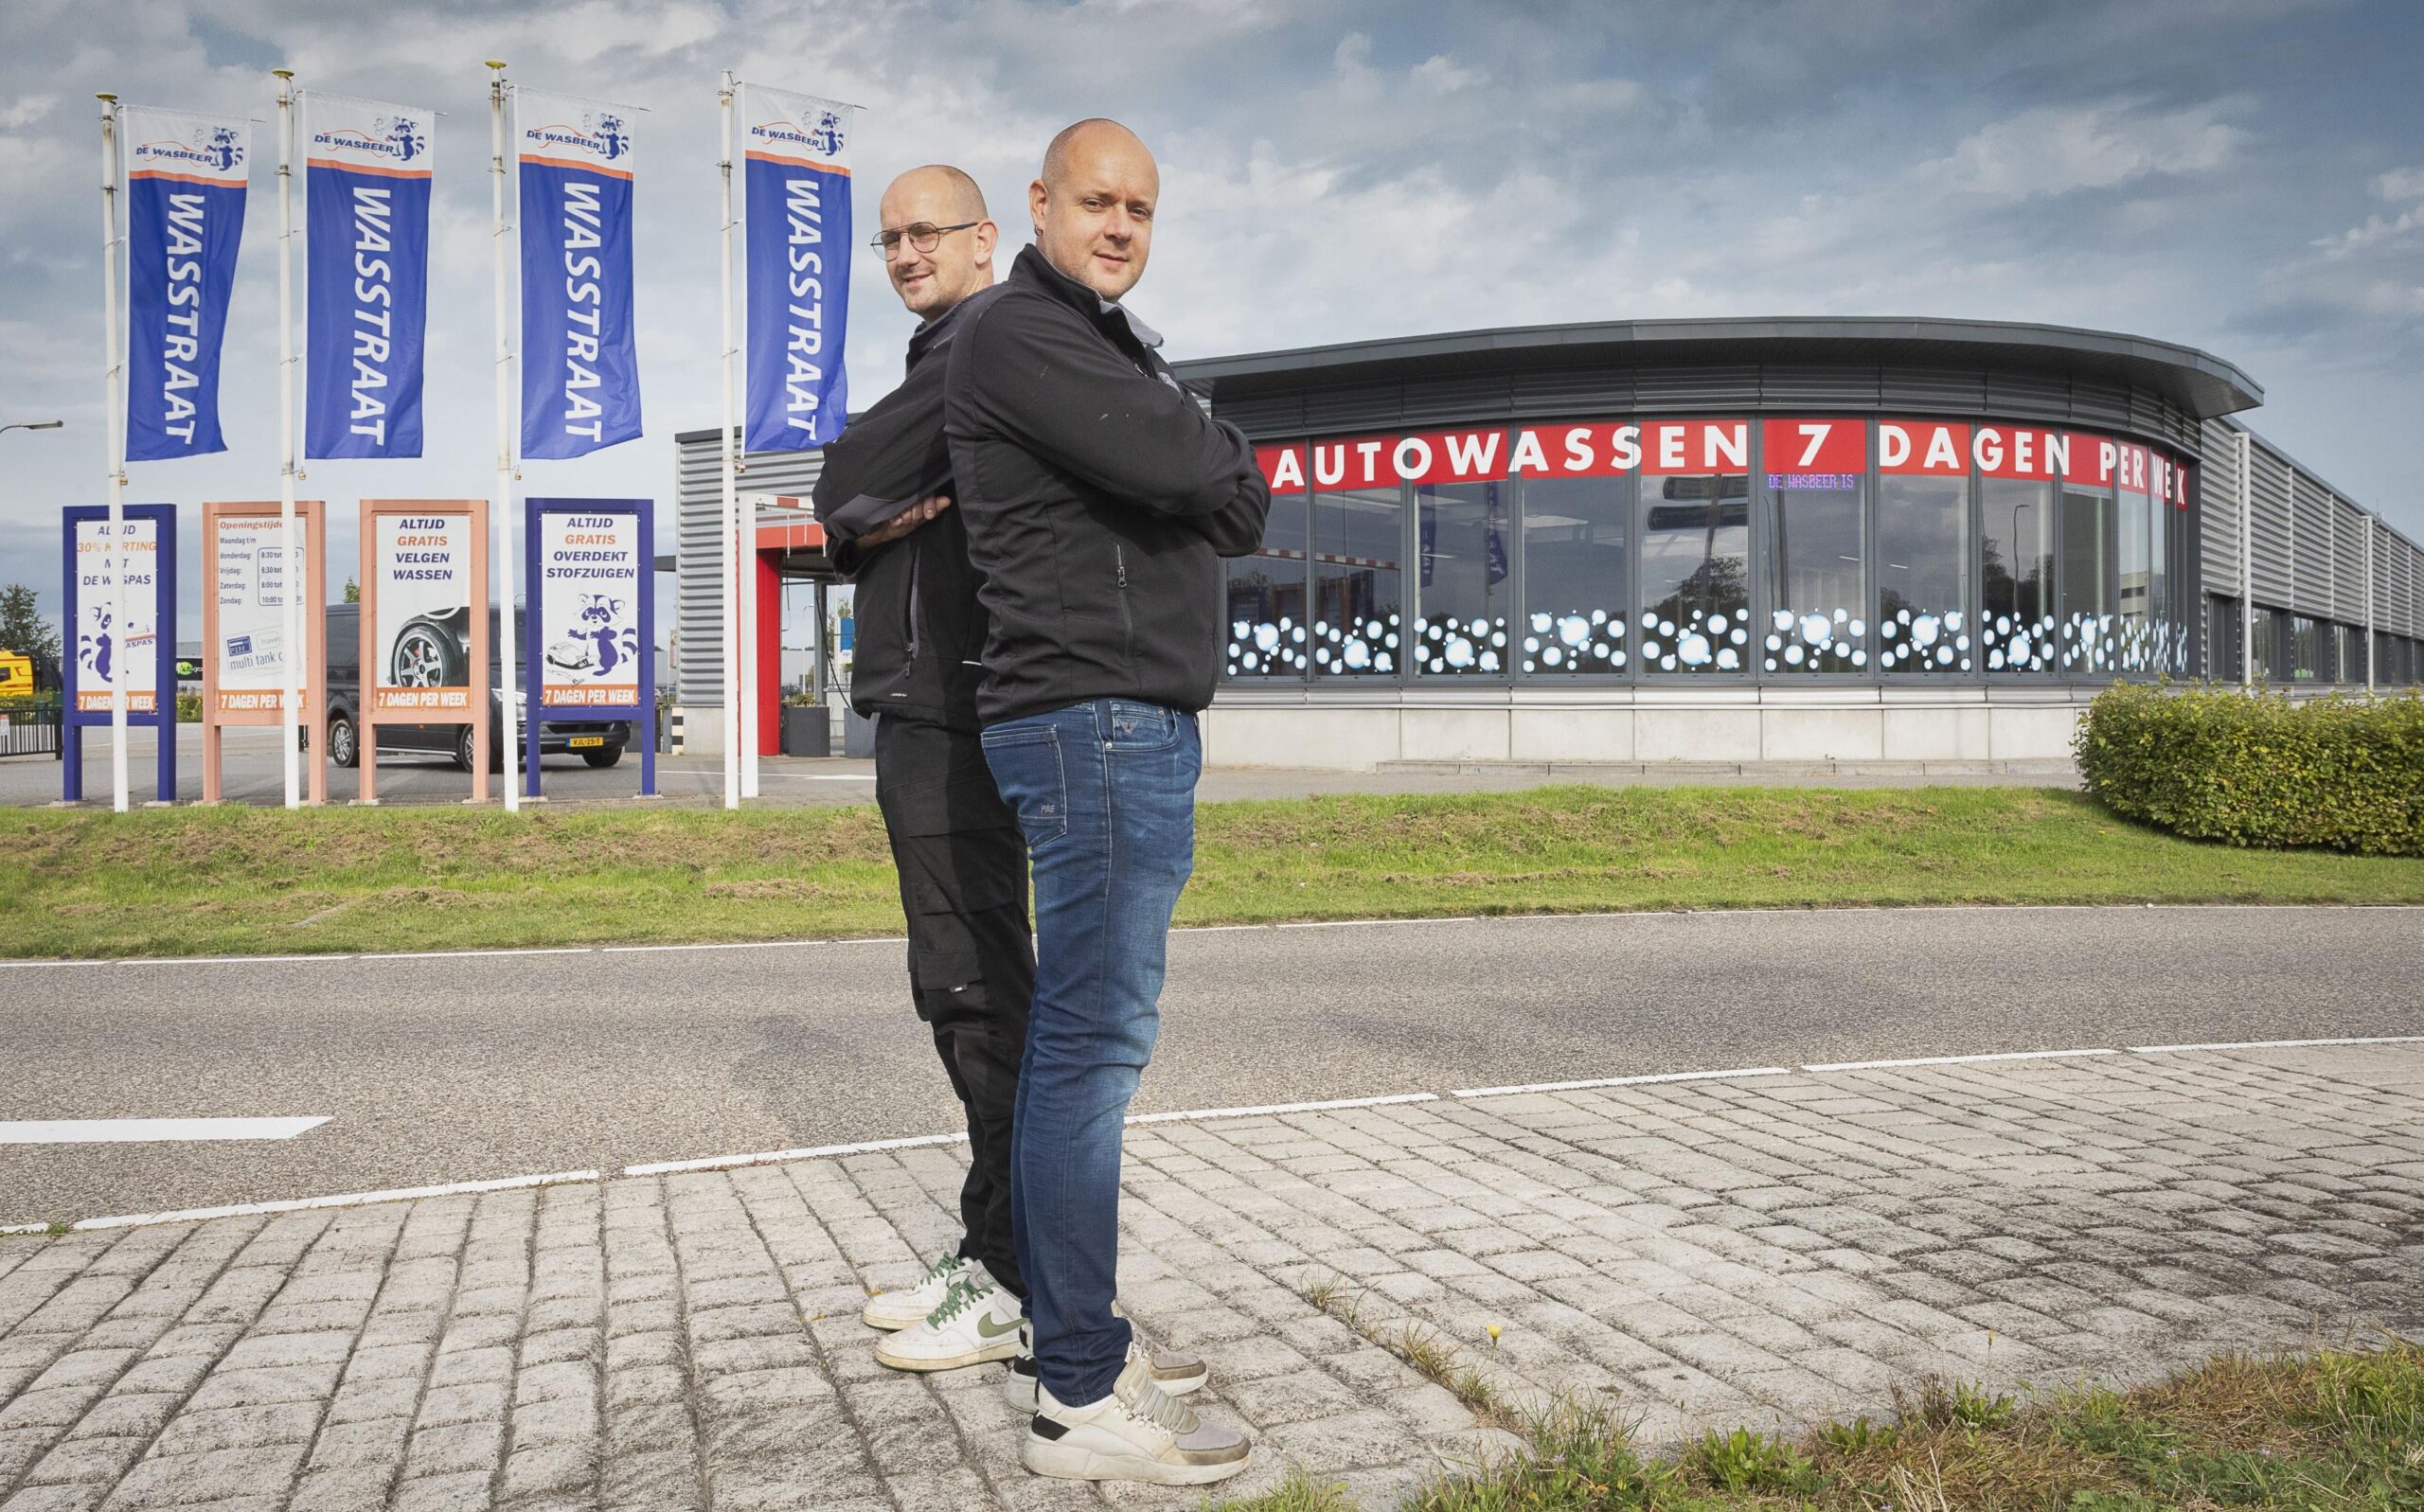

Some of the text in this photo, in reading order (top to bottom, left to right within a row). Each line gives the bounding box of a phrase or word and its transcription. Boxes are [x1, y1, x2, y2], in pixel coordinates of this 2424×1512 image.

[314, 134, 395, 153] DE WASBEER
[526, 130, 600, 151] DE WASBEER
[751, 126, 820, 148] DE WASBEER
[135, 147, 213, 164] DE WASBEER
[350, 186, 391, 446] WASSTRAAT
[563, 181, 602, 443] WASSTRAAT
[785, 179, 822, 441] WASSTRAAT
[164, 192, 205, 445] WASSTRAAT
[1272, 424, 2185, 506] AUTOWASSEN 7 DAGEN PER WEK
[1768, 473, 1854, 489] DE WASBEER IS
[220, 521, 283, 530] Openingstijde
[400, 519, 446, 529] ALTIJD
[566, 517, 614, 528] ALTIJD
[98, 525, 136, 536] ALJD
[105, 541, 157, 552] KRTING
[220, 537, 246, 545] Maandag
[398, 536, 448, 546] GRATIS
[564, 534, 616, 545] GRATIS
[396, 552, 450, 563] VELGEN
[553, 550, 629, 561] OVERDEKT
[393, 569, 453, 580] WASSEN
[546, 567, 635, 578] STOFZUIGEN
[83, 576, 98, 586] DE
[230, 655, 254, 671] multi
[256, 651, 276, 667] tank
[80, 696, 86, 710] 7
[131, 696, 154, 710] WEEK
[222, 694, 228, 709] 7
[228, 694, 258, 709] DAGEN
[259, 694, 277, 709] PER
[379, 692, 468, 706] 7 DAGEN PER WEEK
[544, 689, 635, 703] 7 DAGEN PER WEEK
